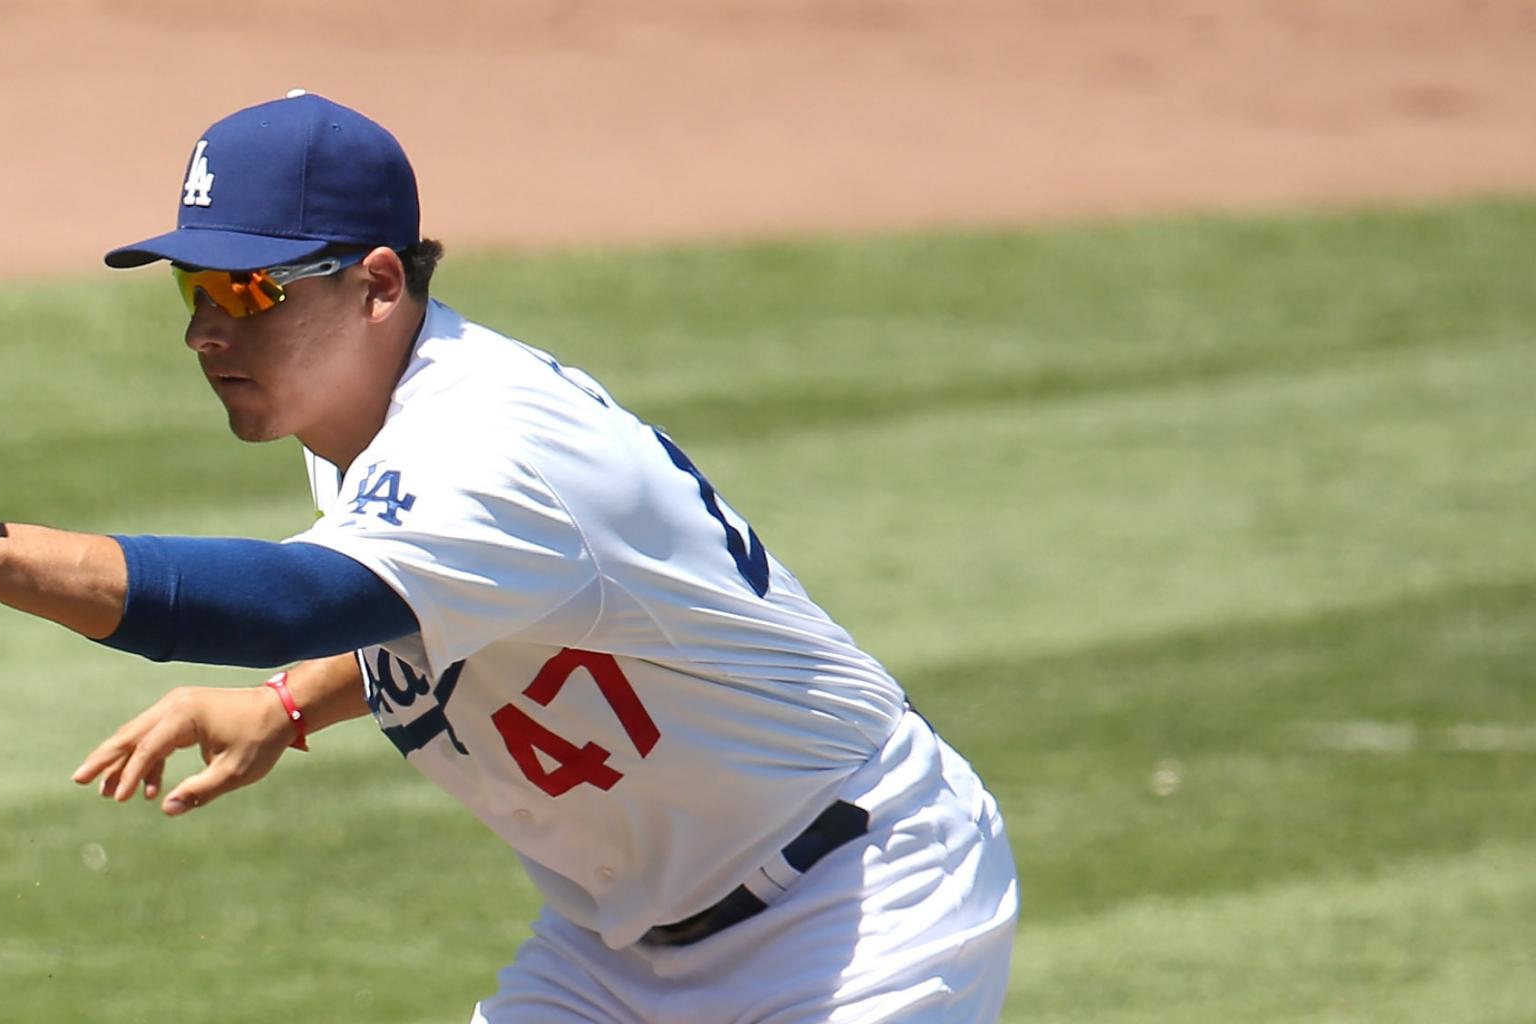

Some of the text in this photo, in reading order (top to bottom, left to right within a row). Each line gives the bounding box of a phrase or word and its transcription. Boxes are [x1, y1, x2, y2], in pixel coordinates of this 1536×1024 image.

[182, 139, 215, 207] LA
[347, 461, 417, 527] LA
[491, 646, 662, 798] 47
